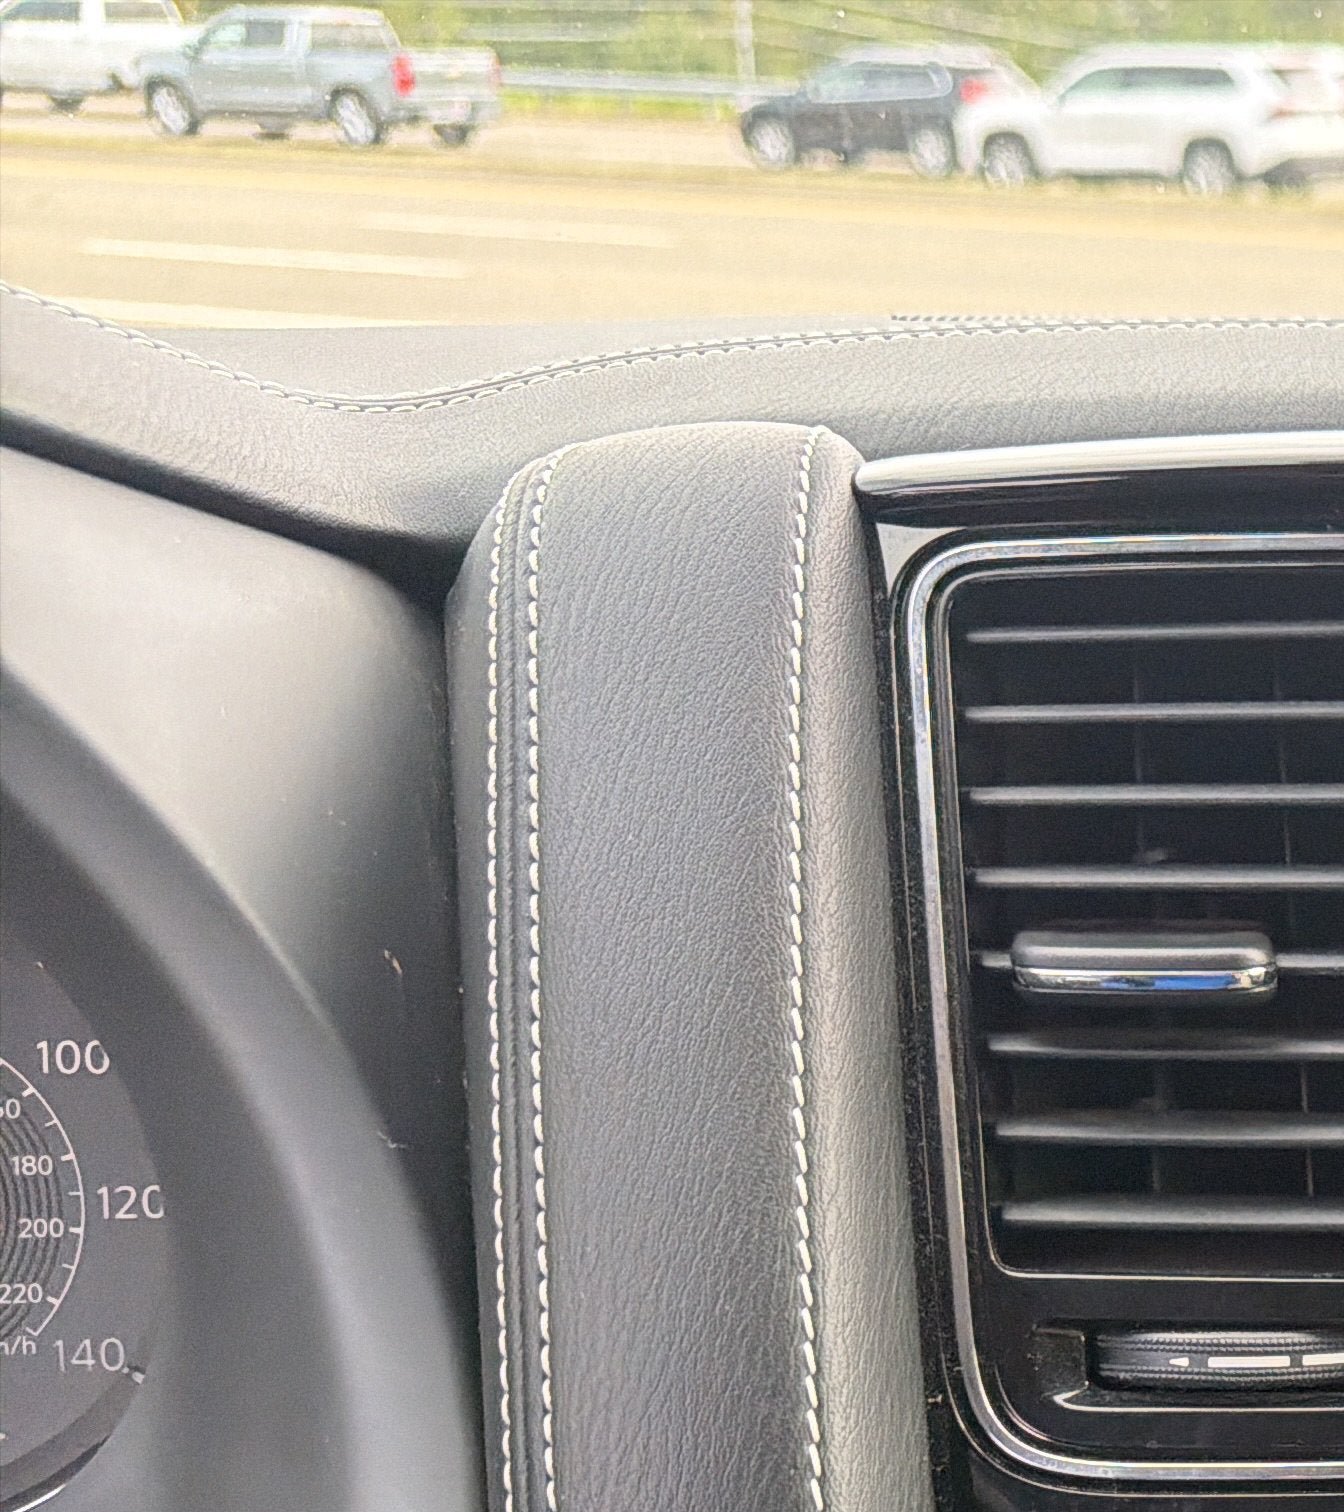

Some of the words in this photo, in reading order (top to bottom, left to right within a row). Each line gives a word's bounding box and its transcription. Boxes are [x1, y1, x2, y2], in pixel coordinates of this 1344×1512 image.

[36, 1038, 111, 1075] 100
[11, 1154, 53, 1177] 180
[96, 1184, 165, 1220] 120
[18, 1217, 65, 1239] 200
[0, 1283, 43, 1304] 220
[54, 1336, 125, 1373] 140
